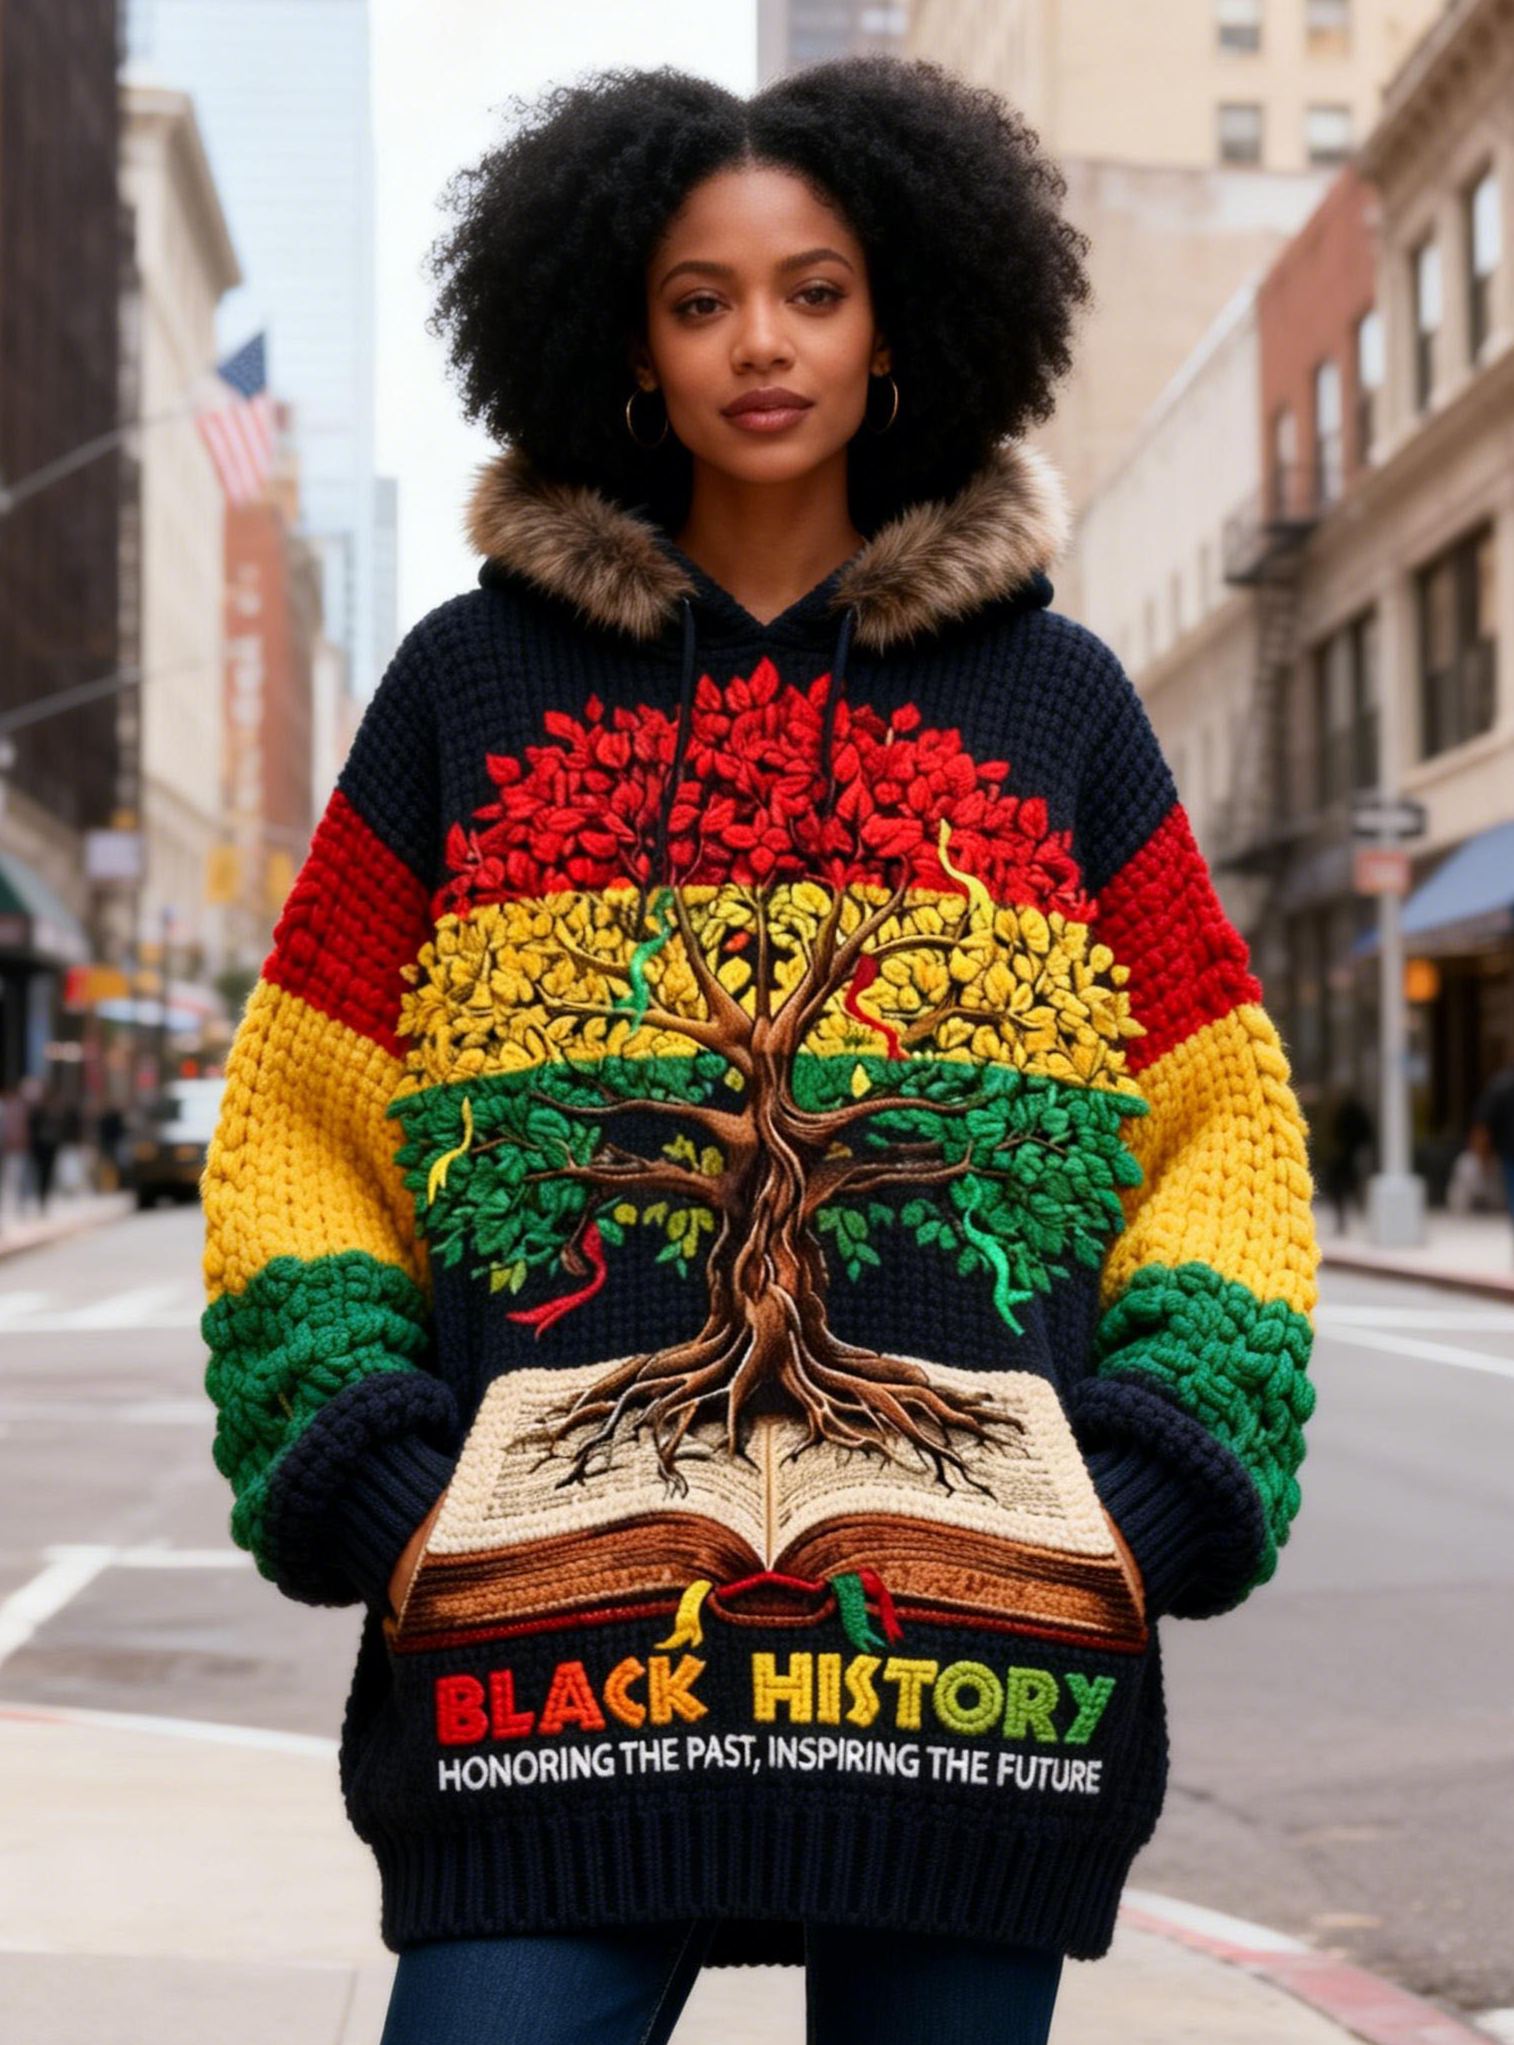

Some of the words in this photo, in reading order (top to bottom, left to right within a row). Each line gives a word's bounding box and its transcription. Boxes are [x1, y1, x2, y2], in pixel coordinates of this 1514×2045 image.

[436, 1654, 708, 1744] BLACK
[751, 1652, 1115, 1744] HISTORY
[438, 1743, 615, 1792] HONORING
[619, 1737, 680, 1772] THE
[687, 1734, 762, 1775] PAST,
[768, 1735, 920, 1775] INSPIRING
[928, 1747, 990, 1786] THE
[996, 1752, 1103, 1794] FUTURE
